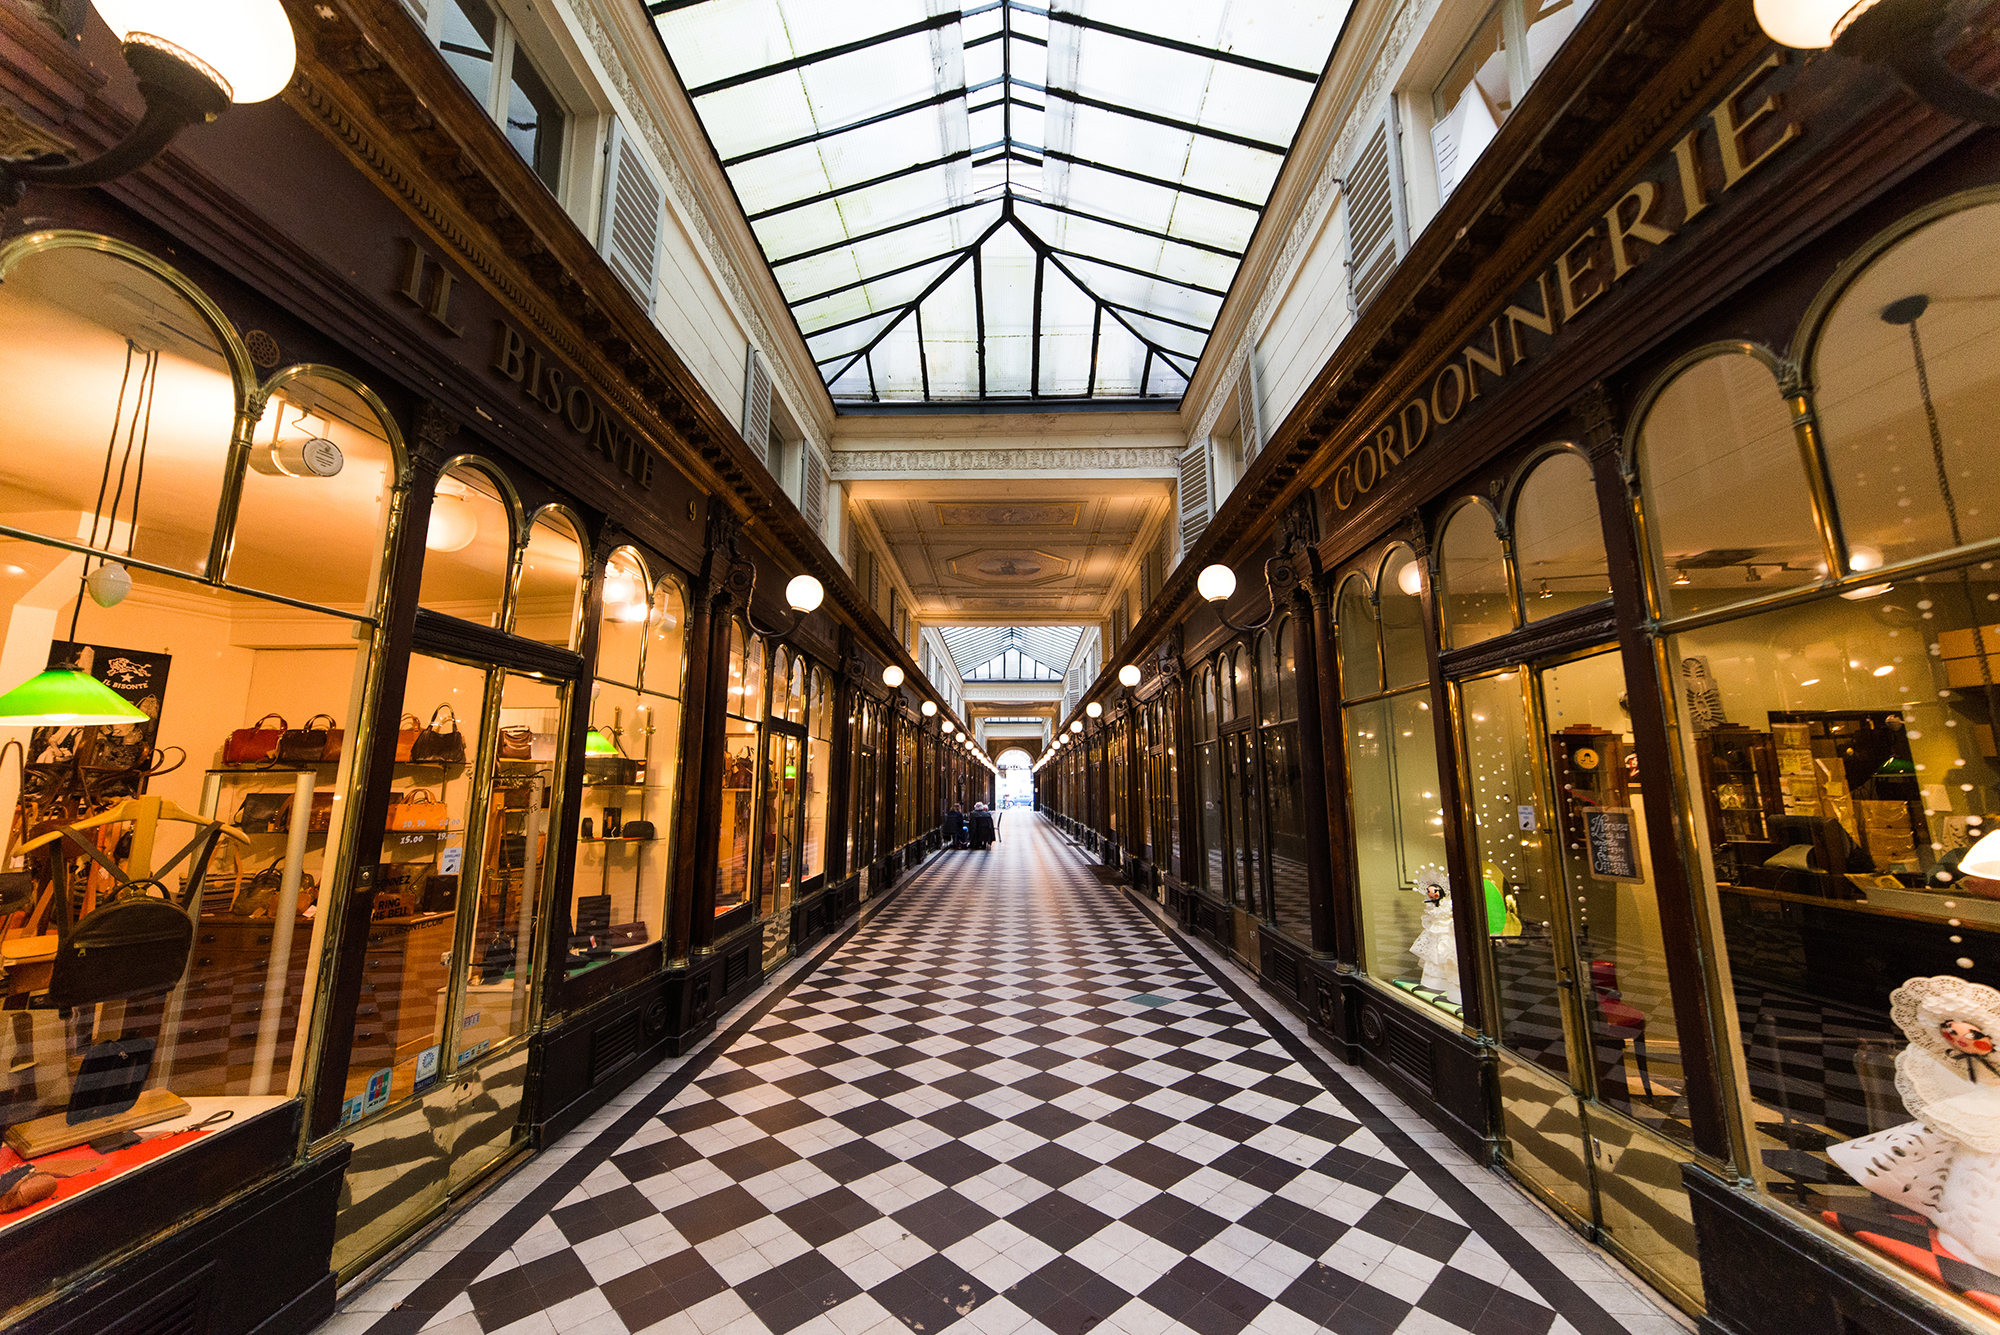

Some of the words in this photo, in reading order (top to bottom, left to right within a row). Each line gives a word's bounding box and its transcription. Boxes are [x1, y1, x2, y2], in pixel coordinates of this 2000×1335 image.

[1334, 52, 1797, 511] CORDONNERIE
[402, 239, 466, 338] IL
[494, 318, 656, 492] BISONTE
[688, 501, 697, 521] 9
[103, 679, 110, 687] IL
[113, 681, 148, 690] BISONTE
[403, 820, 425, 828] 10.30
[400, 835, 423, 844] 15.00
[437, 832, 457, 840] 19.00
[378, 898, 400, 910] RING
[372, 910, 385, 921] HE
[388, 906, 408, 919] BELL
[370, 1080, 388, 1093] JCB
